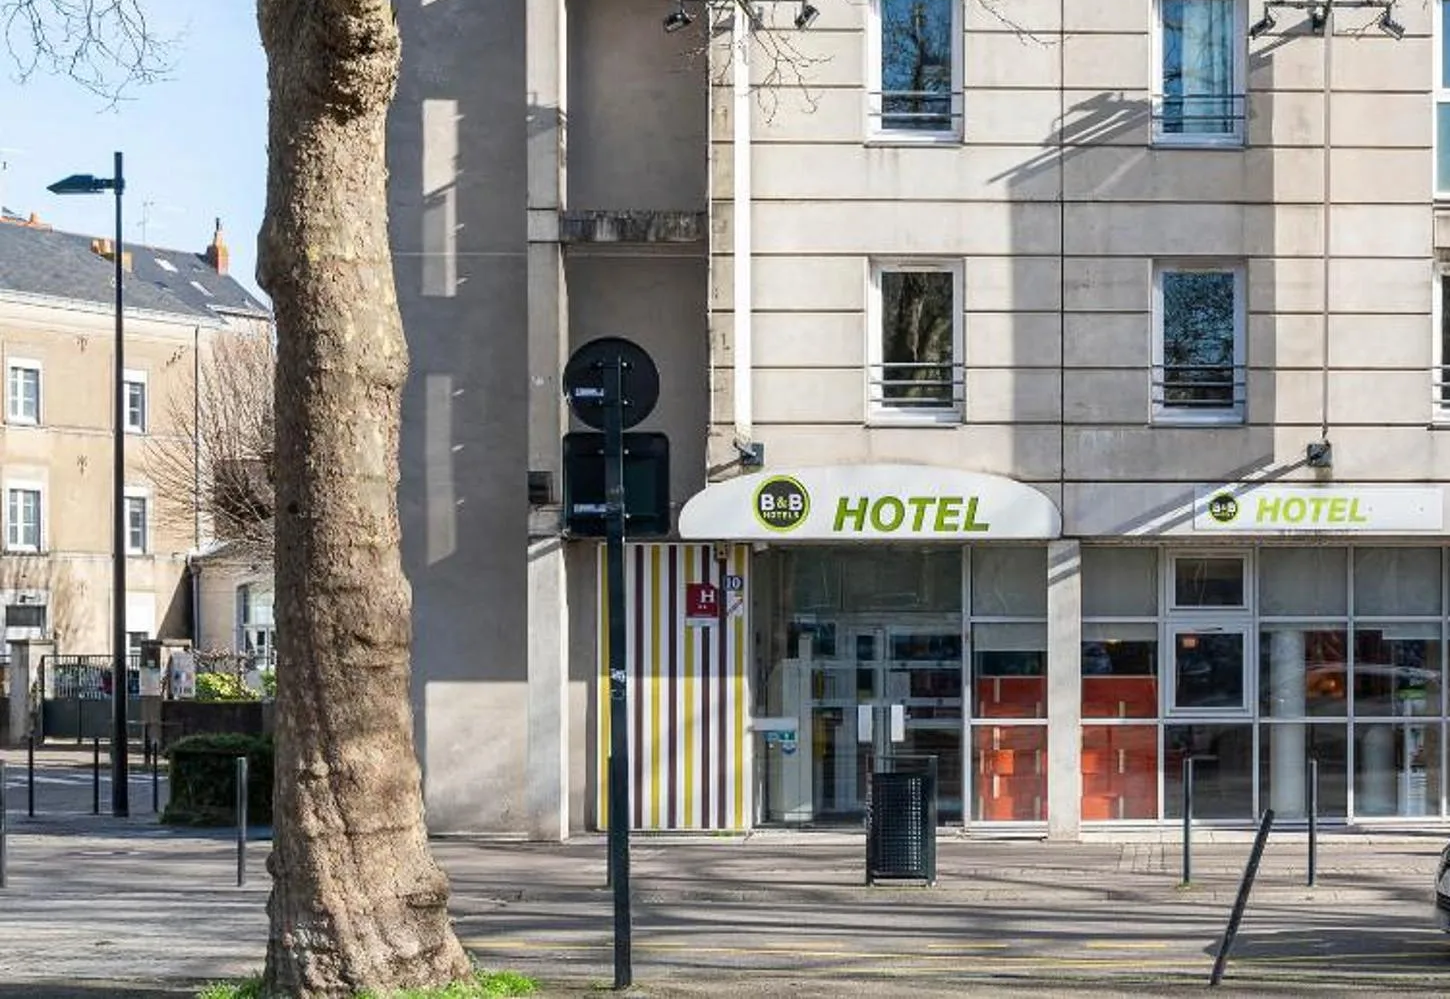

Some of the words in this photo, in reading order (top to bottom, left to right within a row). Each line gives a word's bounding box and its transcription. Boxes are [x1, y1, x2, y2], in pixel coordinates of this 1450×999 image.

[761, 494, 803, 511] B&B
[1256, 497, 1367, 524] HOTEL
[833, 496, 990, 532] HOTEL
[726, 576, 742, 590] 10
[701, 590, 714, 603] H
